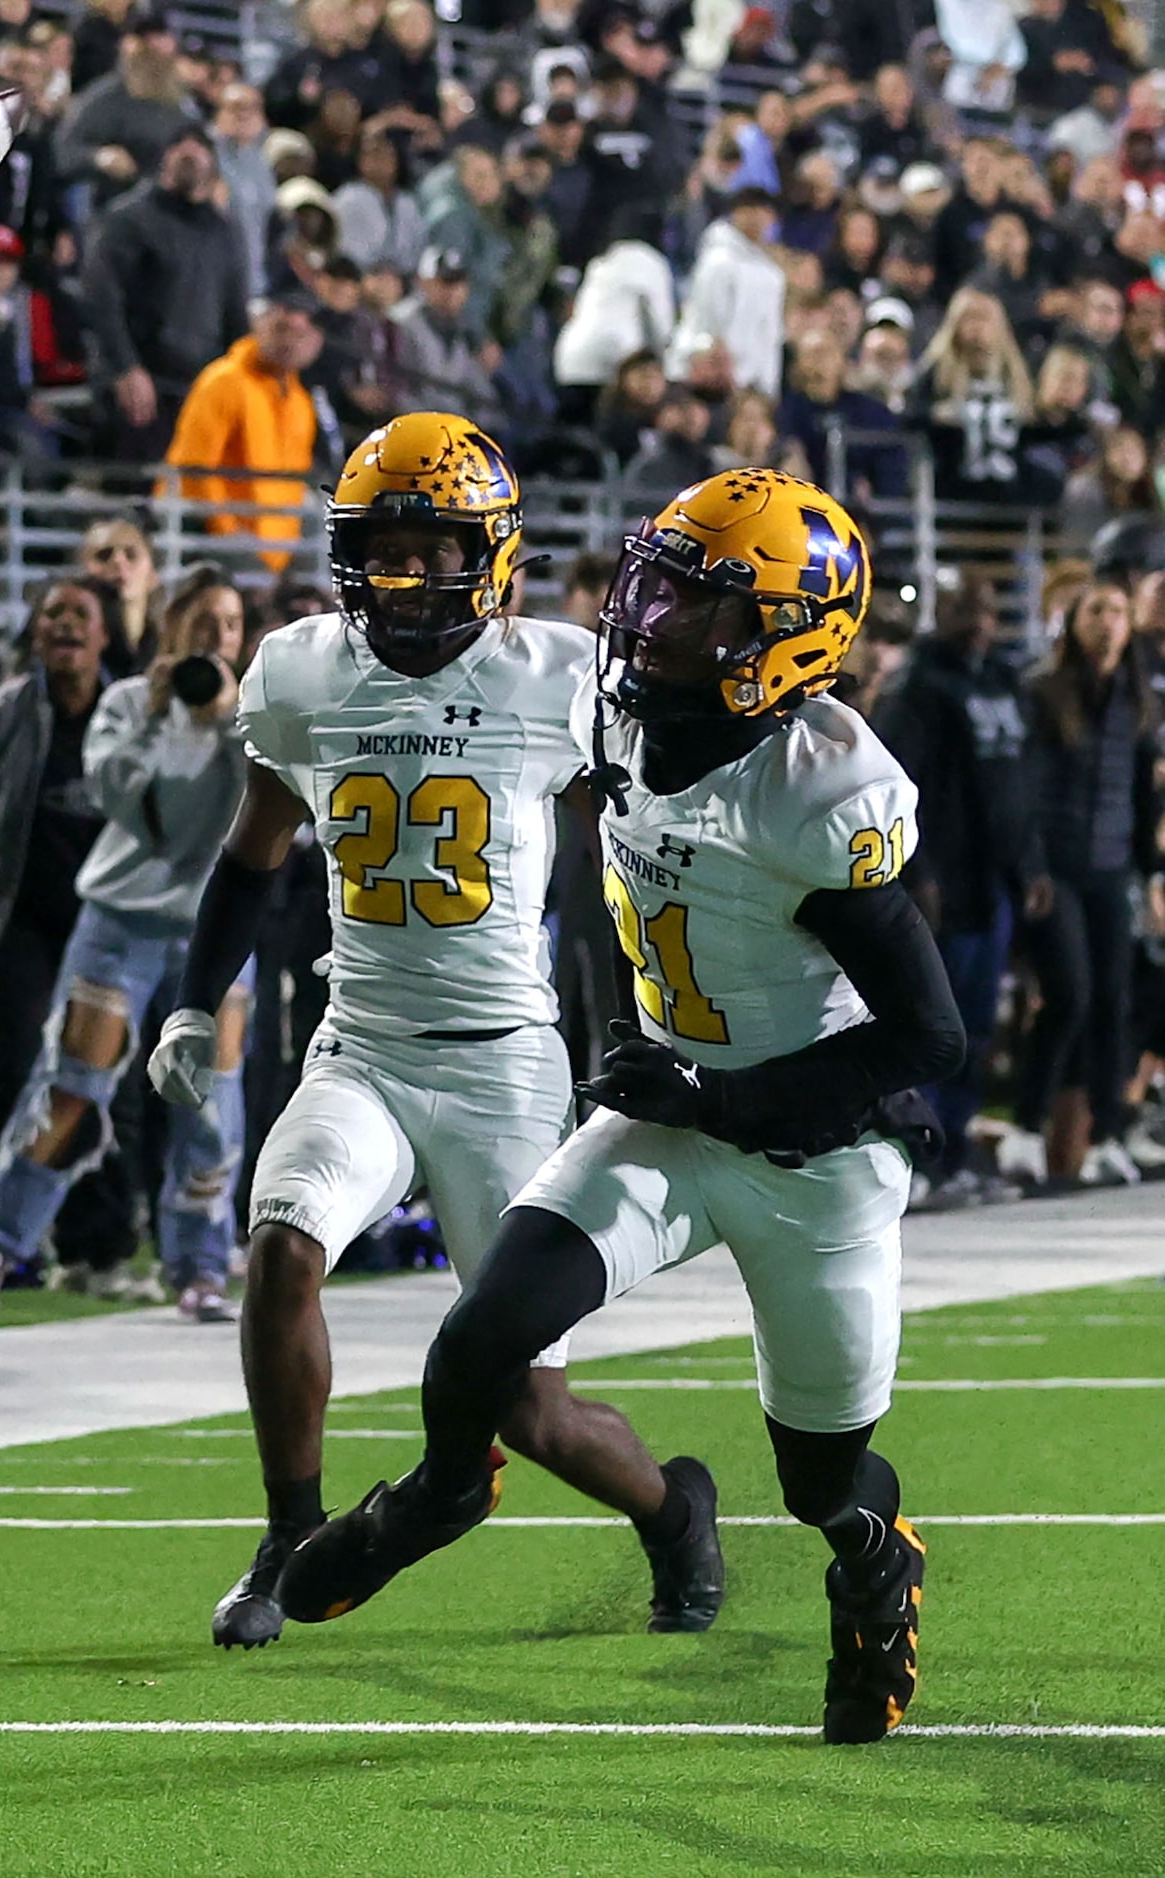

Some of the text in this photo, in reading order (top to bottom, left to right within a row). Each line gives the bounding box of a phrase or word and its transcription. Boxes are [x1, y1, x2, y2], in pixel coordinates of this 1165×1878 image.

[356, 734, 470, 758] MCKINNEY
[328, 771, 494, 929] 23
[849, 816, 904, 889] 21
[603, 862, 731, 1045] 21
